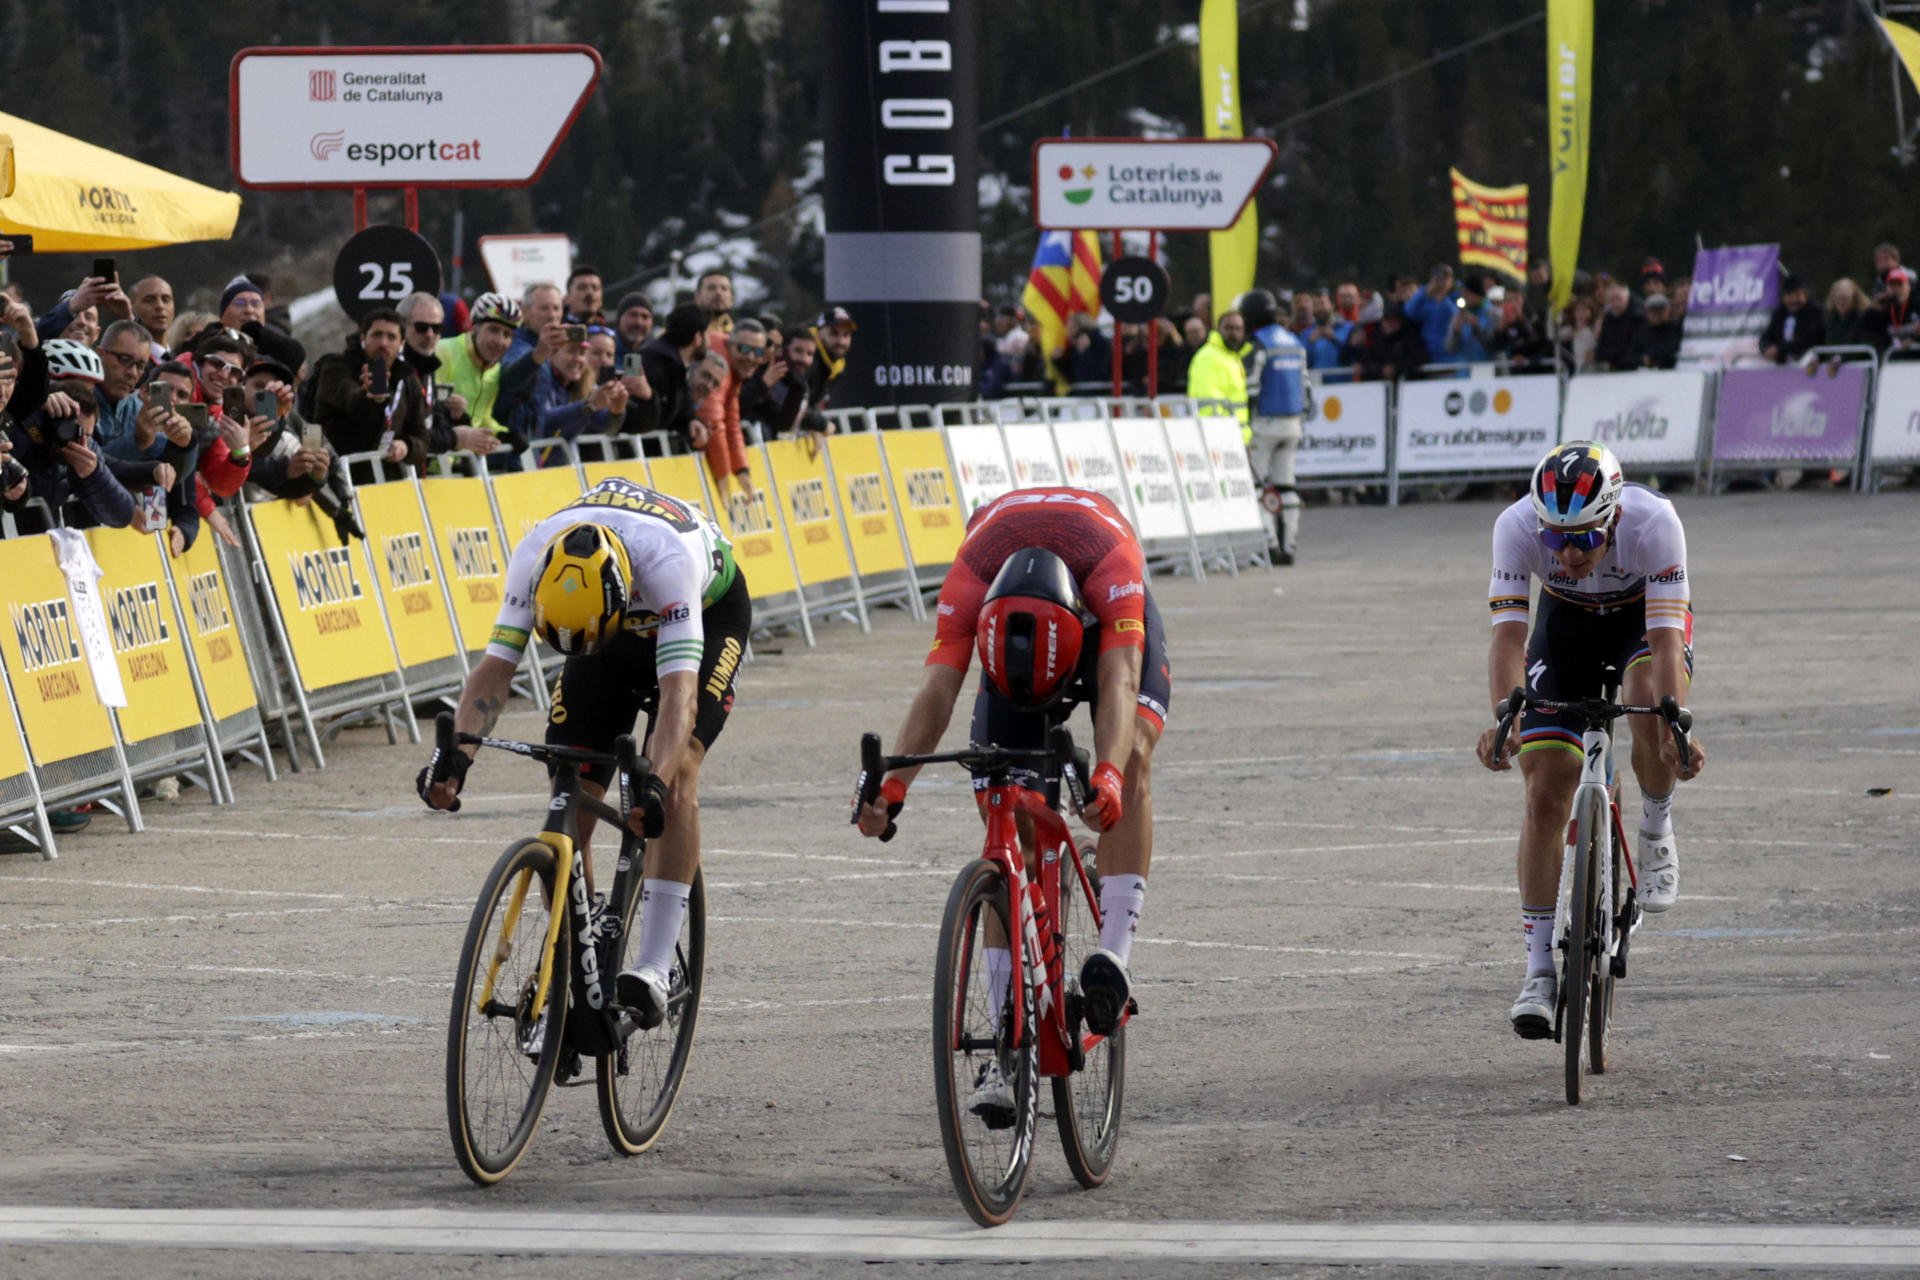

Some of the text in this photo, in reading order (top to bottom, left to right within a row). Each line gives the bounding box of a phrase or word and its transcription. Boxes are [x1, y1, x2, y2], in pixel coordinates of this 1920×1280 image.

[343, 72, 426, 86] Generalitat
[343, 89, 443, 105] de Catalunya
[347, 138, 482, 167] esportcat
[1108, 163, 1223, 184] Loteries de
[1108, 184, 1223, 208] Catalunya
[357, 262, 414, 300] 25
[1114, 276, 1153, 303] 50
[1409, 427, 1547, 447] ScrubDesigns
[286, 546, 364, 612] MORITZ
[102, 581, 171, 654] MORITZ
[9, 598, 82, 673] MORITZ
[987, 614, 998, 676] TREK
[1045, 619, 1059, 681] TREK
[705, 636, 742, 702] JUMBO
